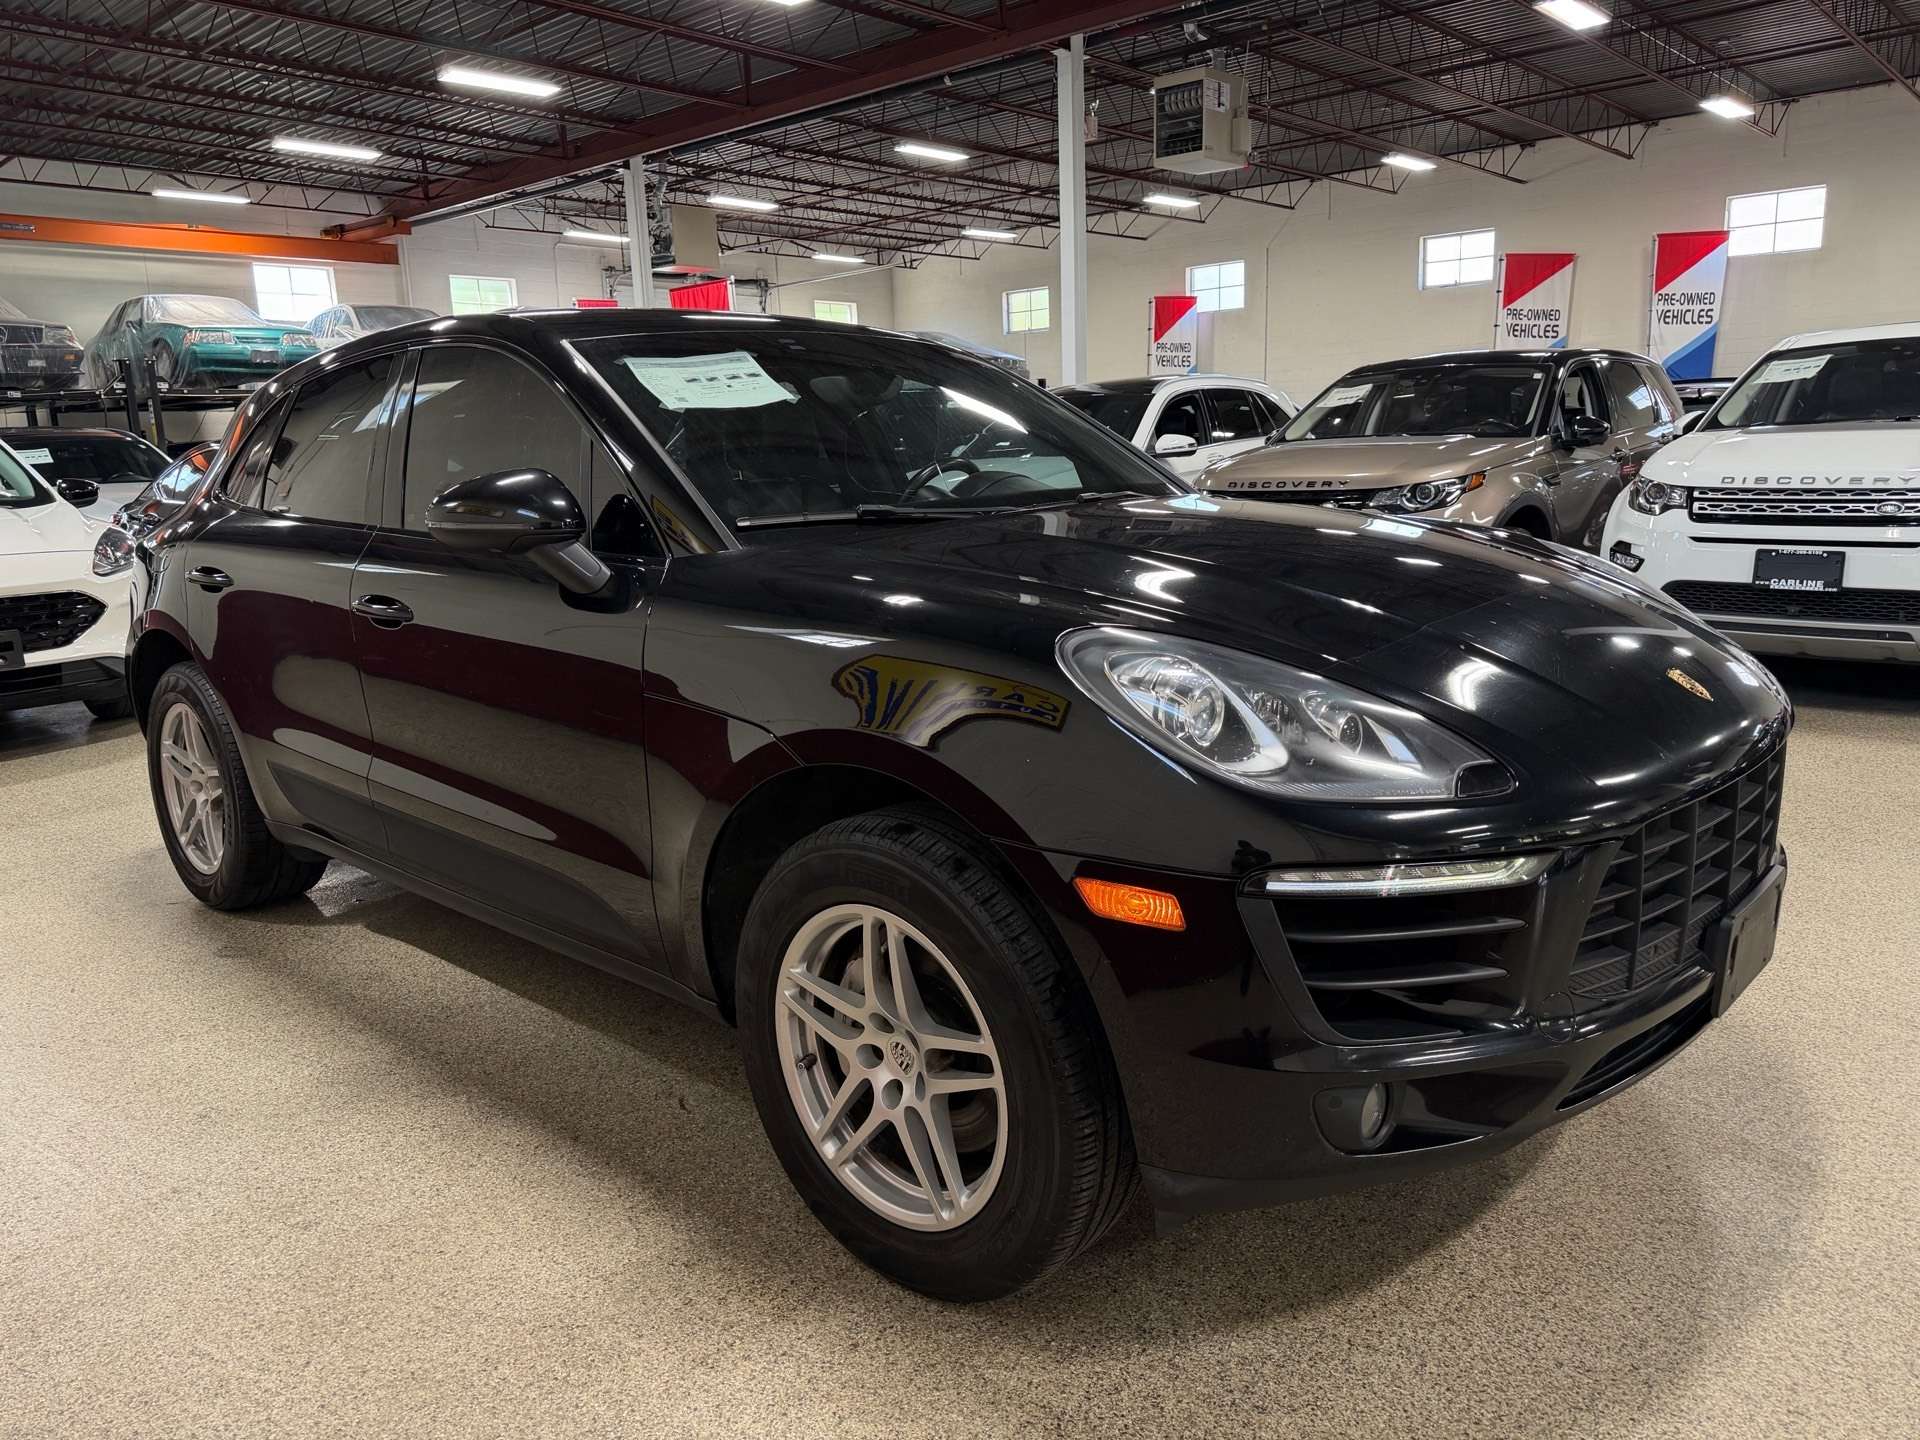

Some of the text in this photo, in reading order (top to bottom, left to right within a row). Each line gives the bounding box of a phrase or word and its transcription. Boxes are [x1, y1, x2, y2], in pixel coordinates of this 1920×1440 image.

[1657, 292, 1716, 306] PRE-OWNED
[1506, 308, 1561, 321] PRE-OWNED
[1656, 308, 1714, 325] VEHICLES
[1506, 323, 1559, 339] VEHICLES
[1156, 342, 1192, 353] PRE-OWNED
[1155, 354, 1192, 368] VEHICLES
[1227, 480, 1349, 489] DISCOVERY
[1720, 476, 1917, 485] DISCOVERY
[1770, 578, 1824, 588] CARLINE
